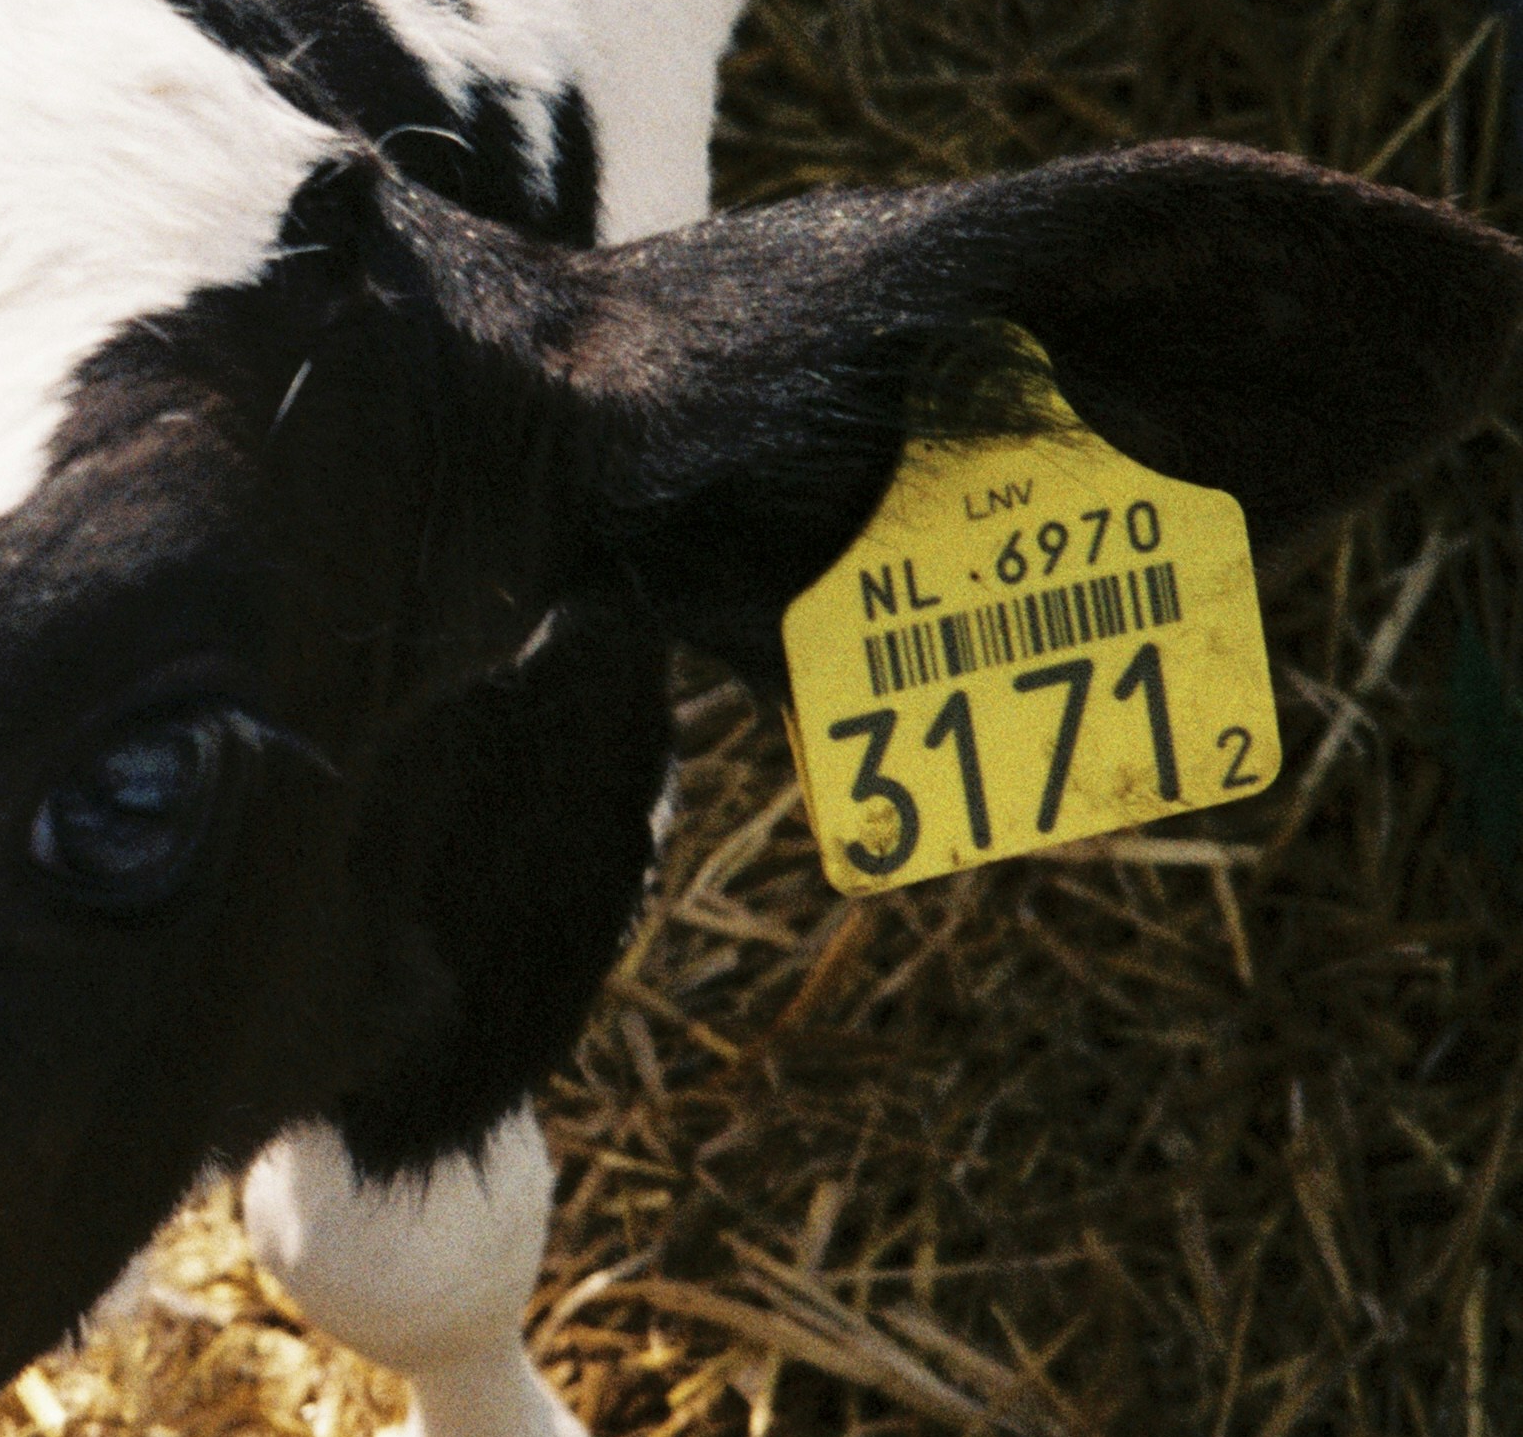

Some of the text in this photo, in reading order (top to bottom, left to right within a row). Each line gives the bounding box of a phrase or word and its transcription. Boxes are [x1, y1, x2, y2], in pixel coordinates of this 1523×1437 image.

[964, 479, 1033, 520] LNV
[860, 500, 1161, 621] NL 6970
[829, 642, 1259, 875] 3171 2
